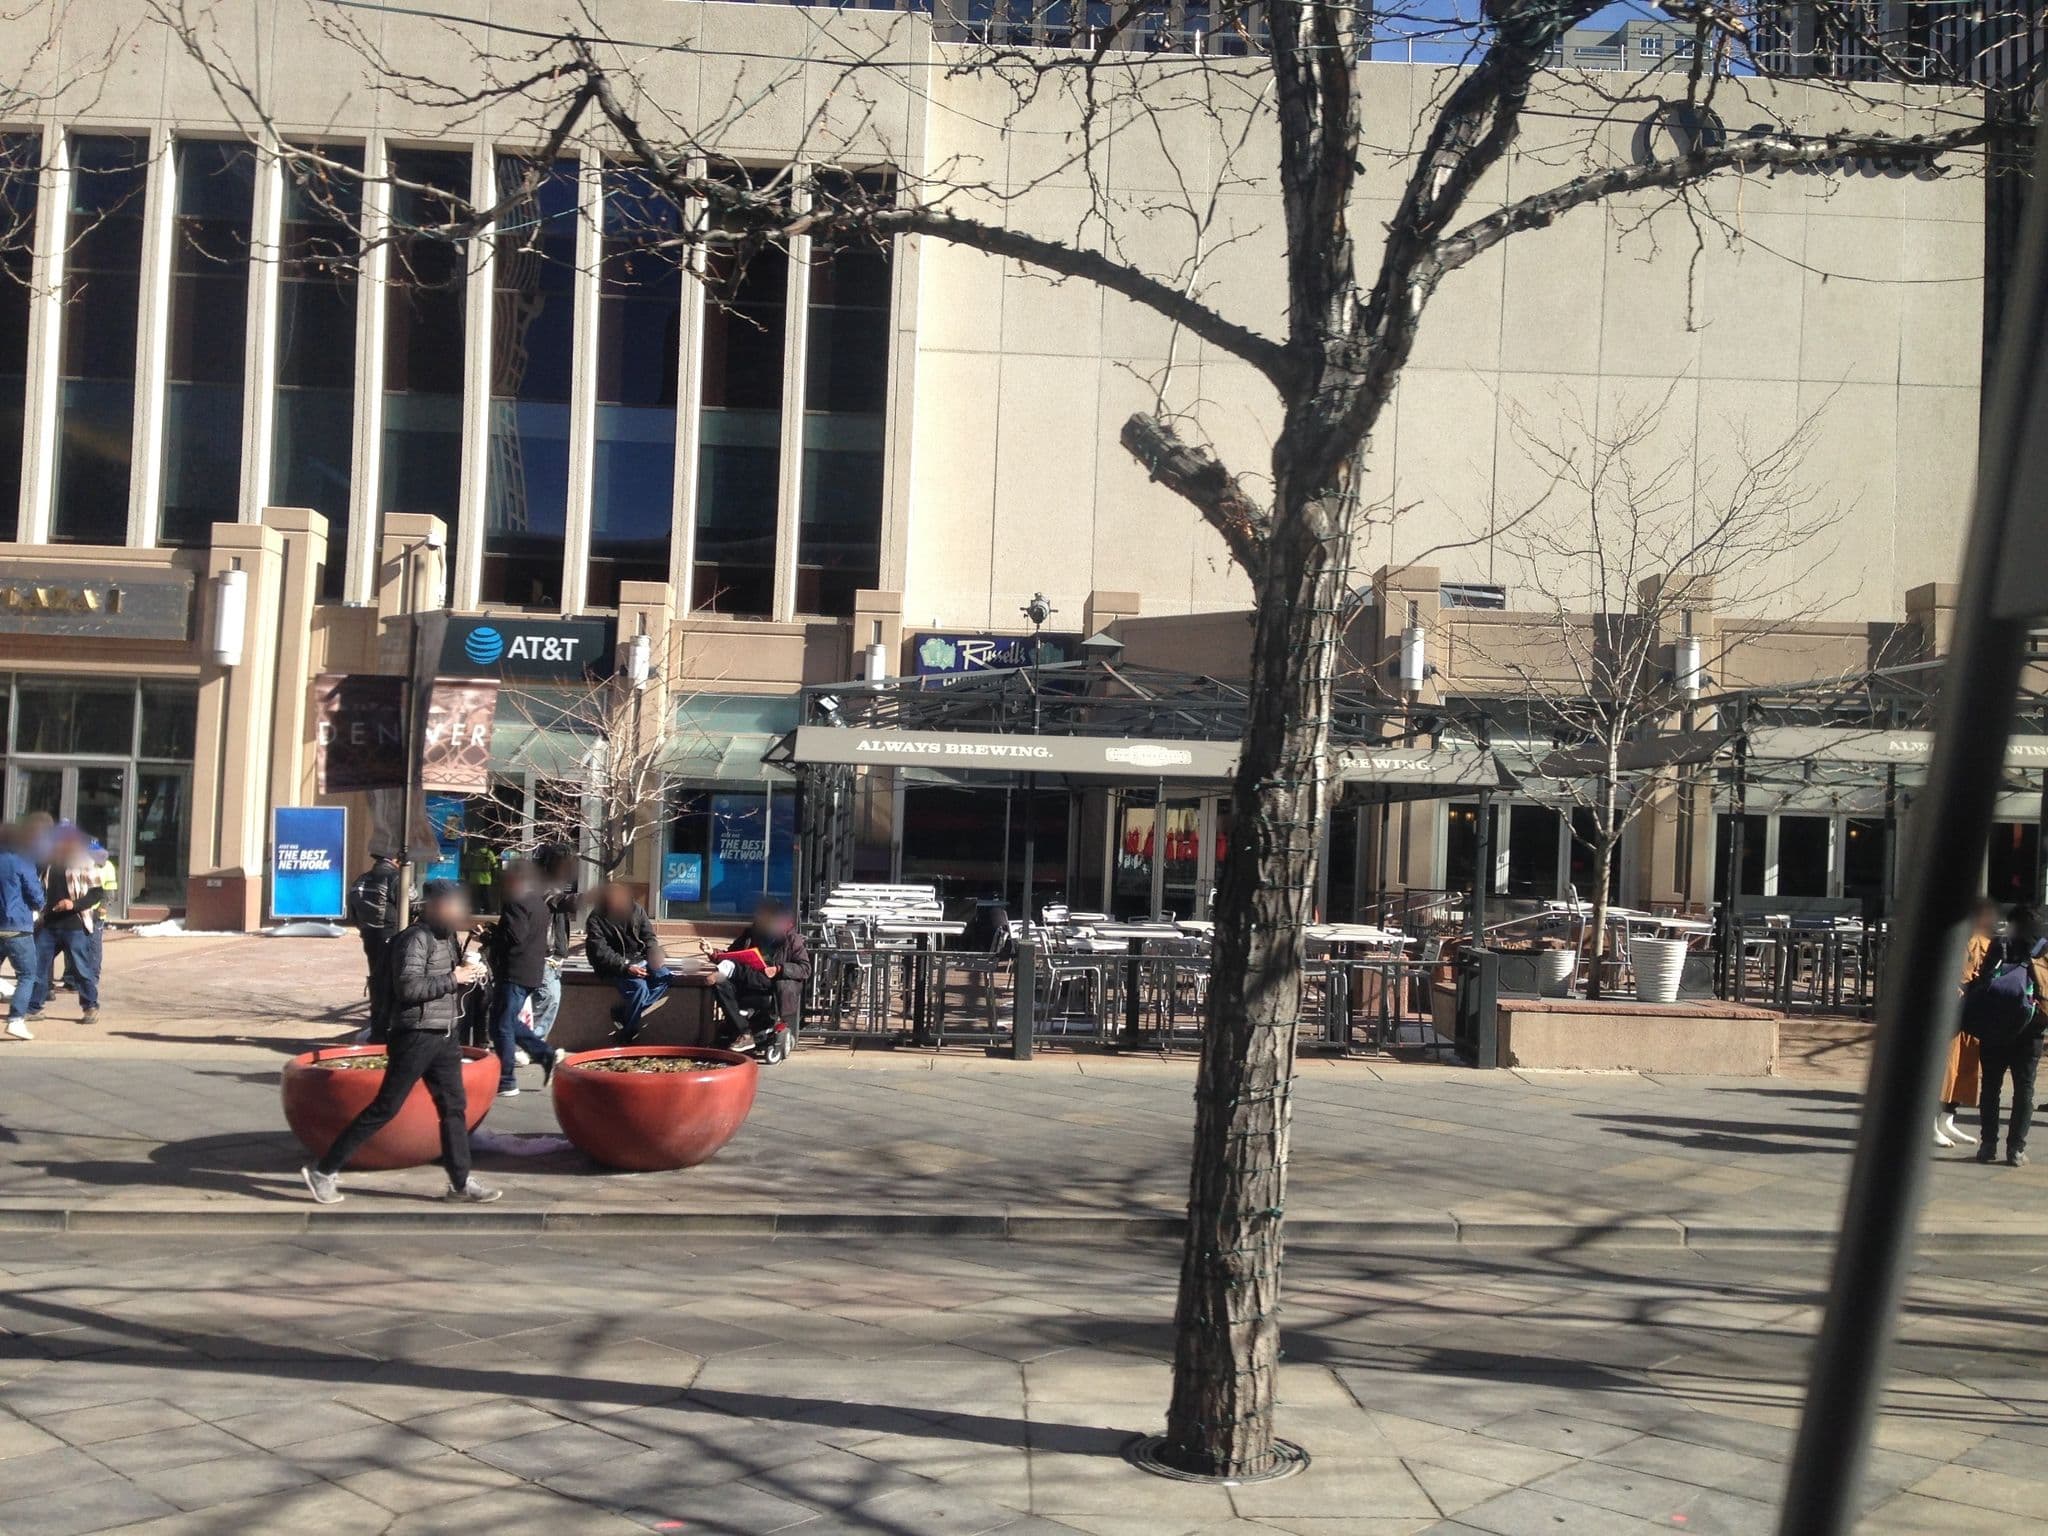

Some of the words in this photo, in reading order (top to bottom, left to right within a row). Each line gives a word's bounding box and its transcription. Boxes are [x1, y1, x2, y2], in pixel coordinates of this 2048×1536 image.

[507, 636, 579, 661] AT&T
[856, 740, 941, 754] ALWAYS
[944, 743, 1054, 757] BREWING.
[720, 839, 741, 849] THE
[278, 849, 299, 860] THE
[300, 850, 328, 860] BEST
[719, 850, 768, 861] NETWOR
[278, 860, 331, 870] NETWORK
